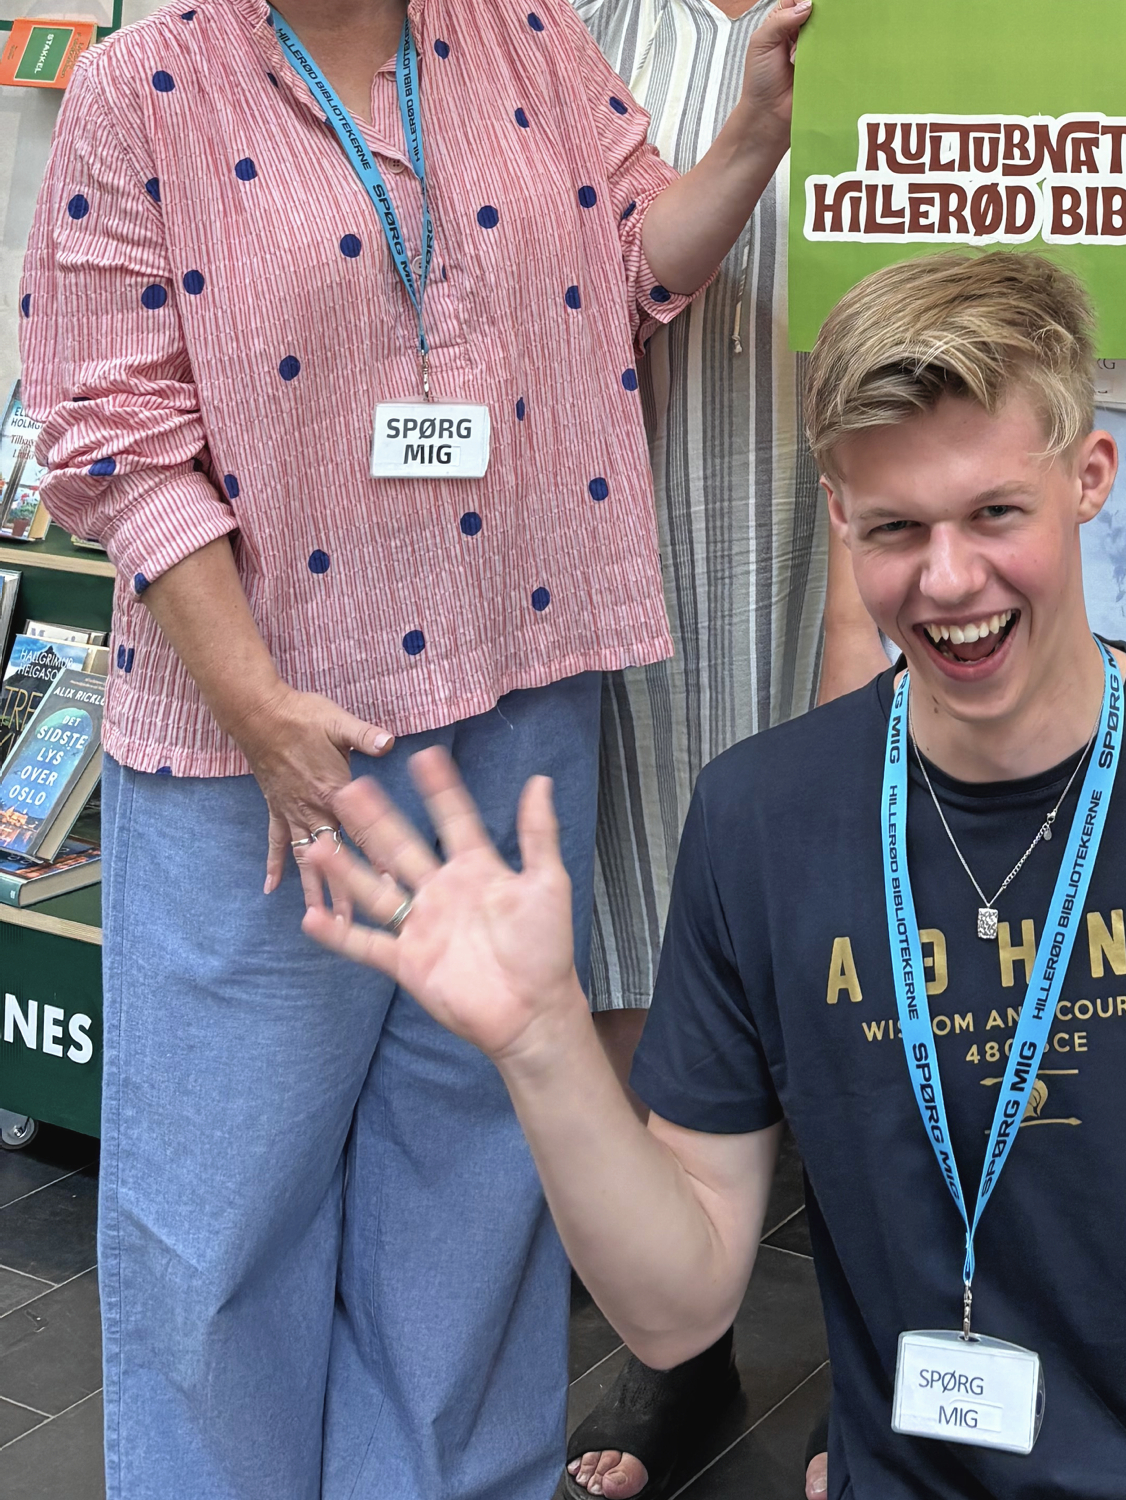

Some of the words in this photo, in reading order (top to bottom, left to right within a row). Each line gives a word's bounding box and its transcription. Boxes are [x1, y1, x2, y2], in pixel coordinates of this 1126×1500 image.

[276, 28, 318, 80] HILLERØD
[315, 80, 372, 171] BIBLIOTEKERNE
[406, 99, 421, 163] HILLERØD
[372, 183, 405, 256] SPØRG
[812, 180, 1036, 236] HILLERØD
[11, 418, 43, 430] HOLMG
[386, 417, 472, 440] SPØRG
[403, 444, 452, 465] MIG
[18, 664, 59, 682] HELGASO
[54, 686, 74, 699] ALIX
[62, 715, 81, 727] DET
[1098, 672, 1121, 770] SPØRG
[37, 726, 89, 749] SIDSTE
[889, 715, 902, 765] MIG
[37, 747, 64, 765] LYS
[21, 765, 58, 787] OVER
[9, 784, 47, 806] OSLO
[888, 783, 902, 878] HILLERØD
[1032, 931, 1066, 1021] HILLERØD
[1057, 788, 1103, 931] BIBLIOTEKERNE
[892, 876, 920, 1022] BIBLIOTEKERNE
[862, 1012, 974, 1042] WIOM
[1042, 1032, 1088, 1053] CE
[911, 1042, 945, 1146] SPØRG
[938, 1146, 961, 1203] MIG
[981, 1098, 1021, 1198] SPØRG
[1010, 1040, 1038, 1095] MIG
[919, 1368, 985, 1396] SPØRG
[938, 1405, 978, 1429] MIG
